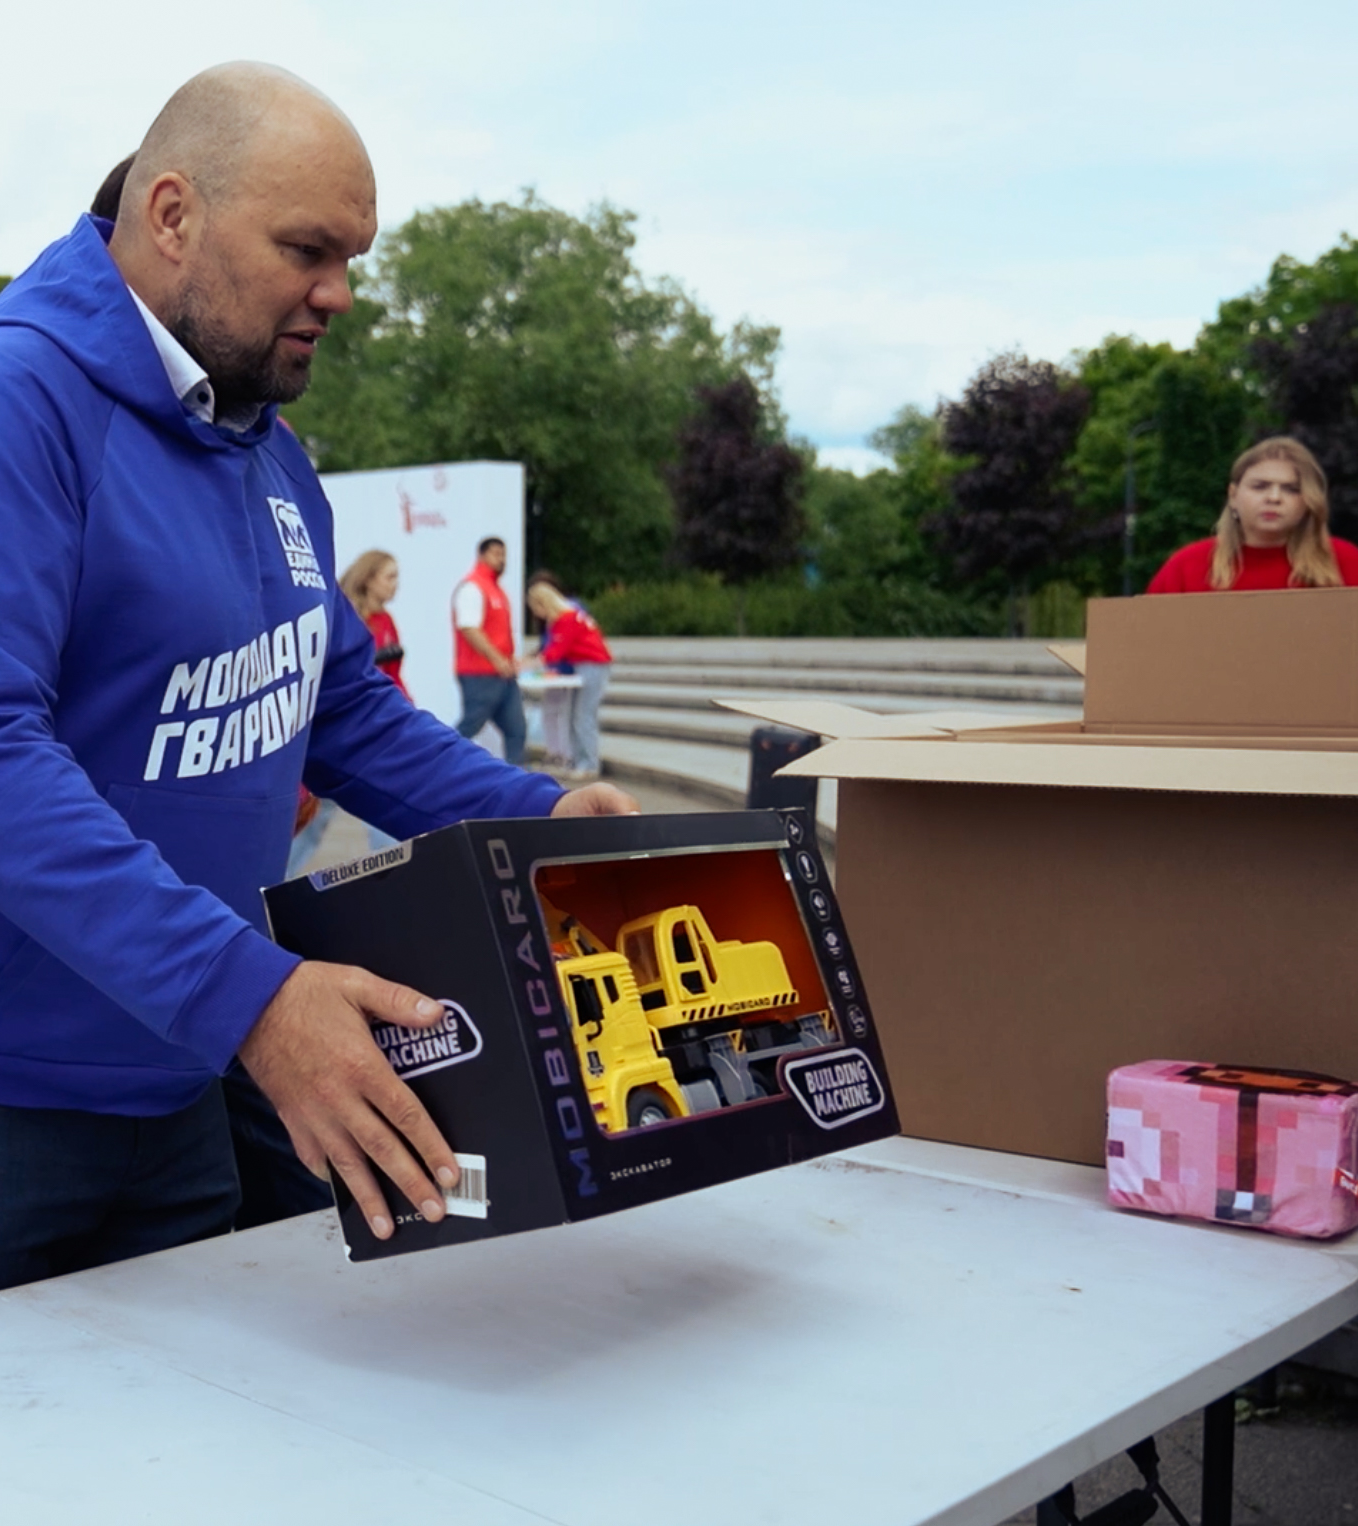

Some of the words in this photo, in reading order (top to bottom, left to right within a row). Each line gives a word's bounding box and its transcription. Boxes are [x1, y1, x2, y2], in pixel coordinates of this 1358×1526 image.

[321, 861, 360, 886] DELUXE
[361, 847, 405, 872] EDITION
[389, 1032, 461, 1068] ACHINE
[804, 1060, 868, 1094] BUILDING
[813, 1082, 873, 1116] MACHINE
